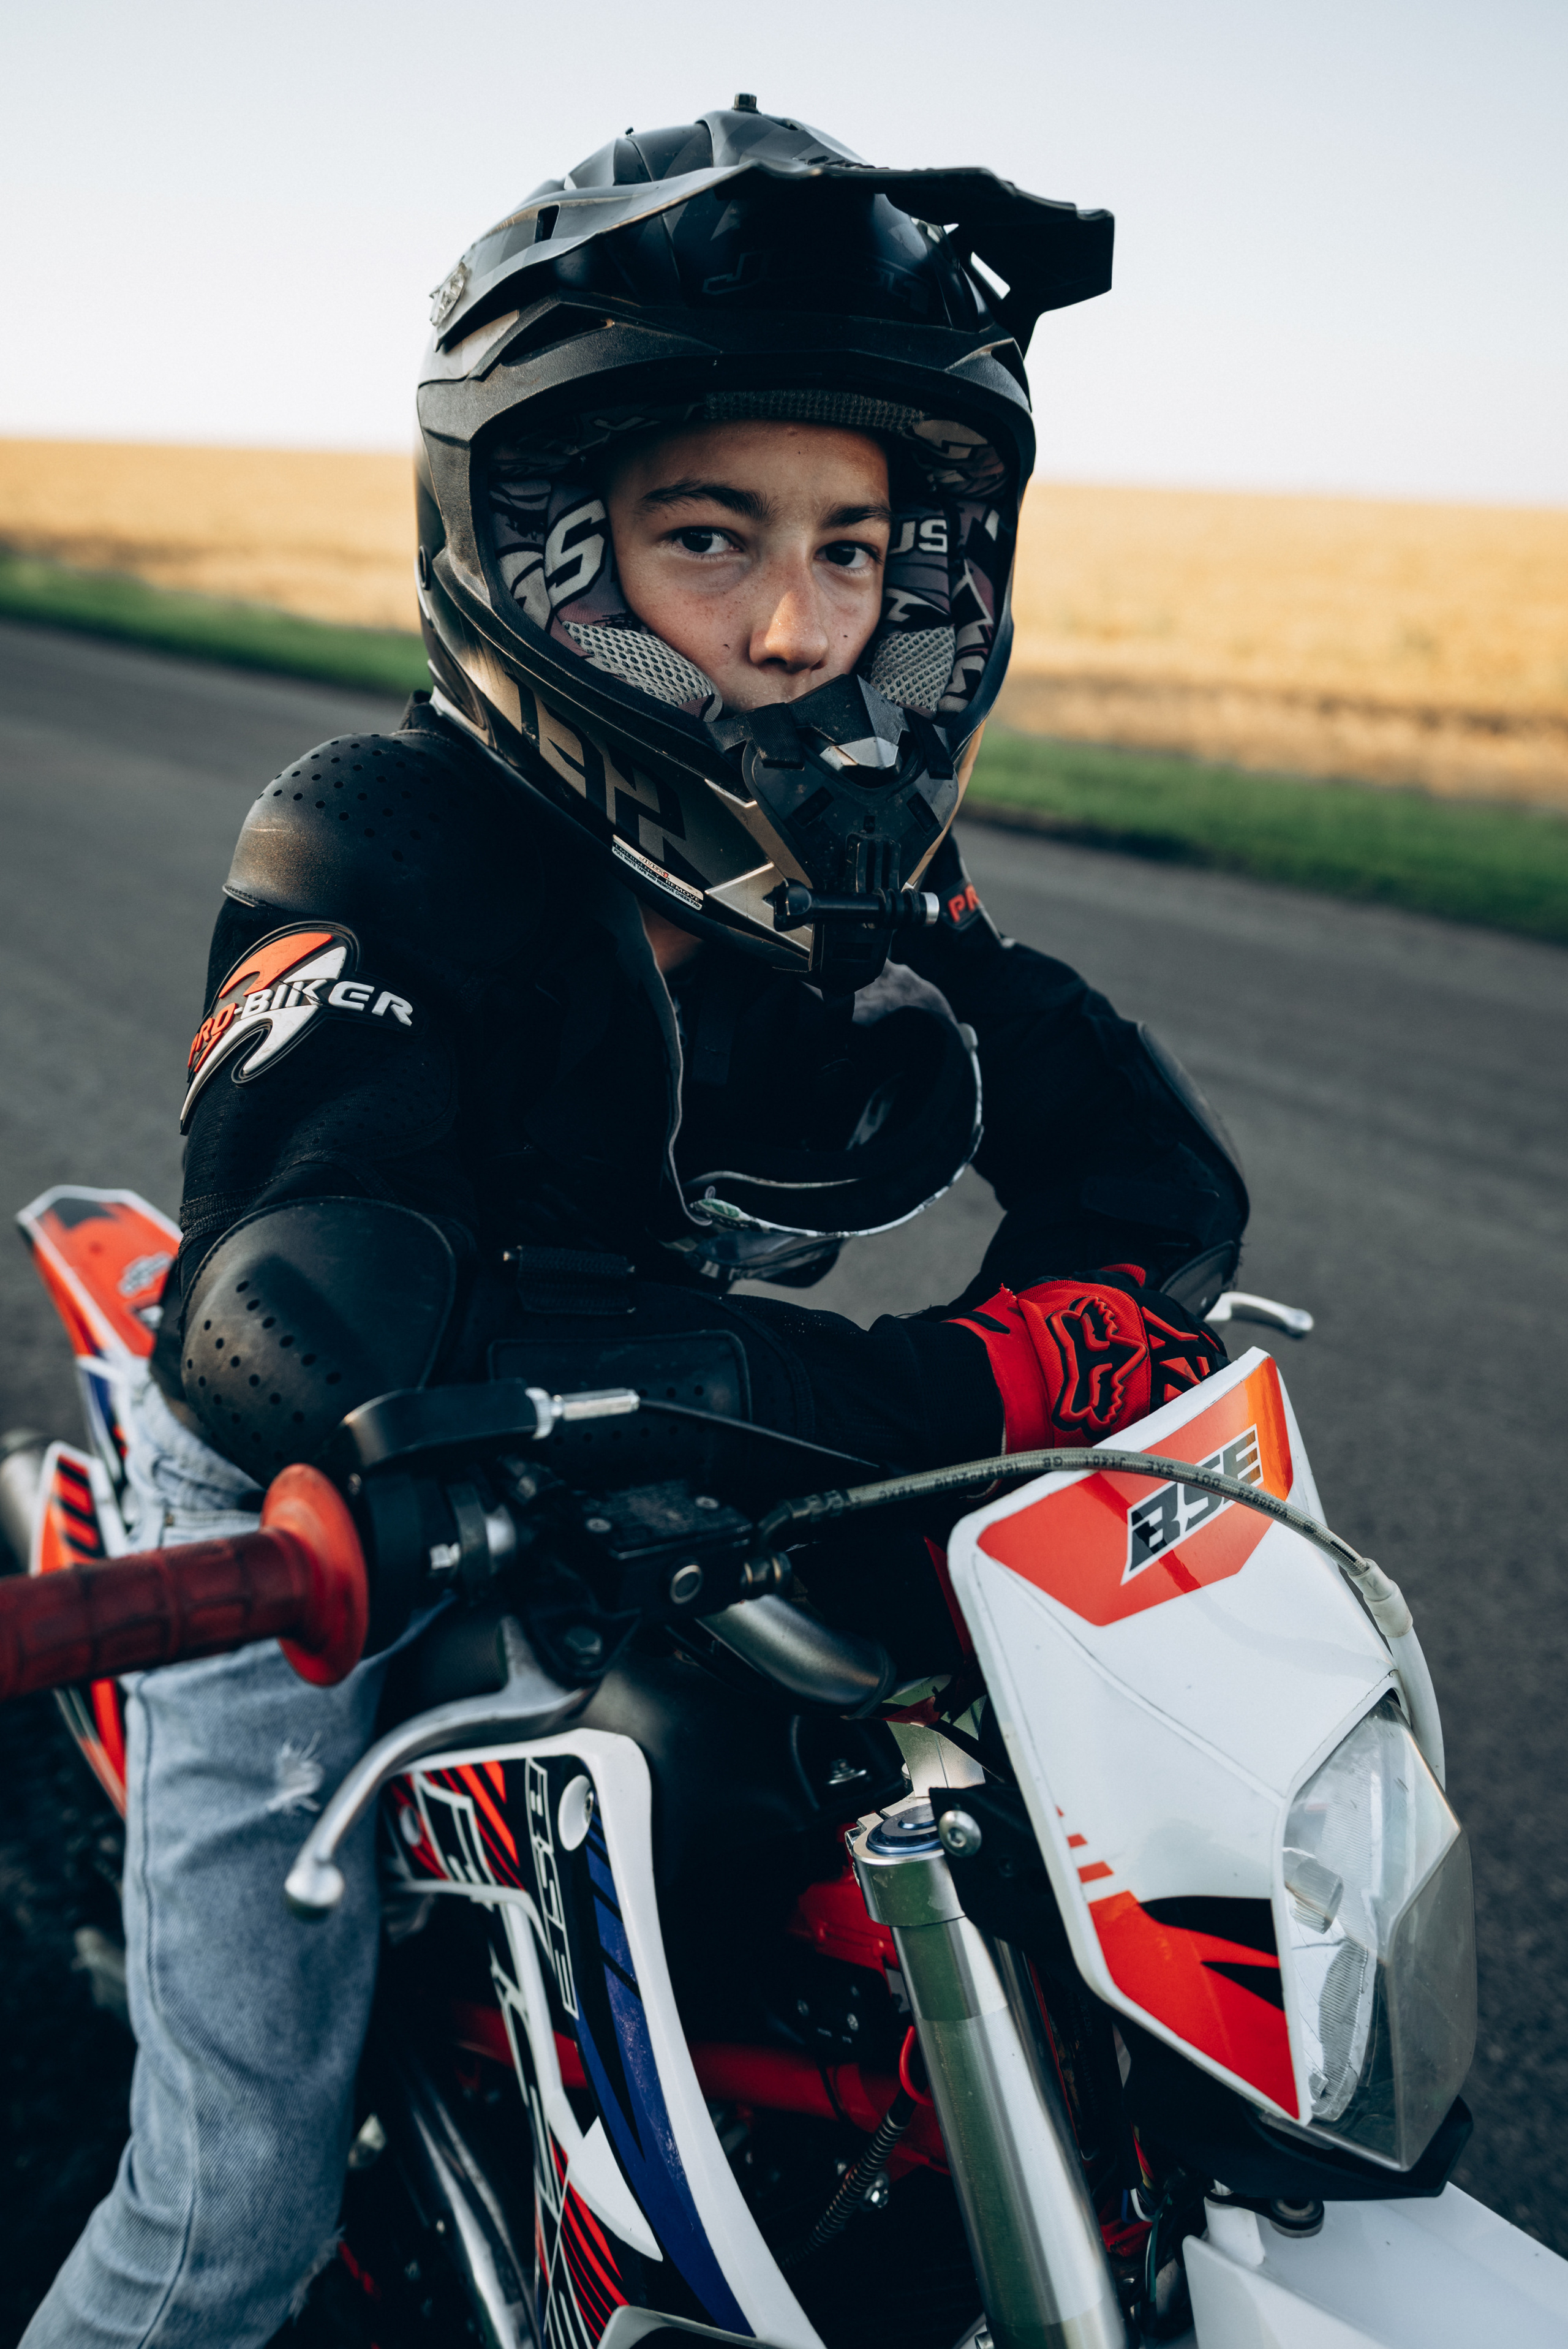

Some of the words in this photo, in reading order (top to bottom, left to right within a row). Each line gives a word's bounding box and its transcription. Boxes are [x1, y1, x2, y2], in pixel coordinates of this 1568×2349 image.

[614, 848, 624, 858] PULL
[624, 855, 636, 867] WHITE
[637, 865, 647, 875] TAPE
[647, 873, 656, 881] AND
[657, 879, 674, 893] REMOVE
[675, 891, 690, 902] CHEEK
[690, 899, 700, 908] PAD
[615, 844, 660, 878] EMERGENCY
[666, 880, 699, 902] REMOVE
[1042, 1456, 1063, 1469] GB
